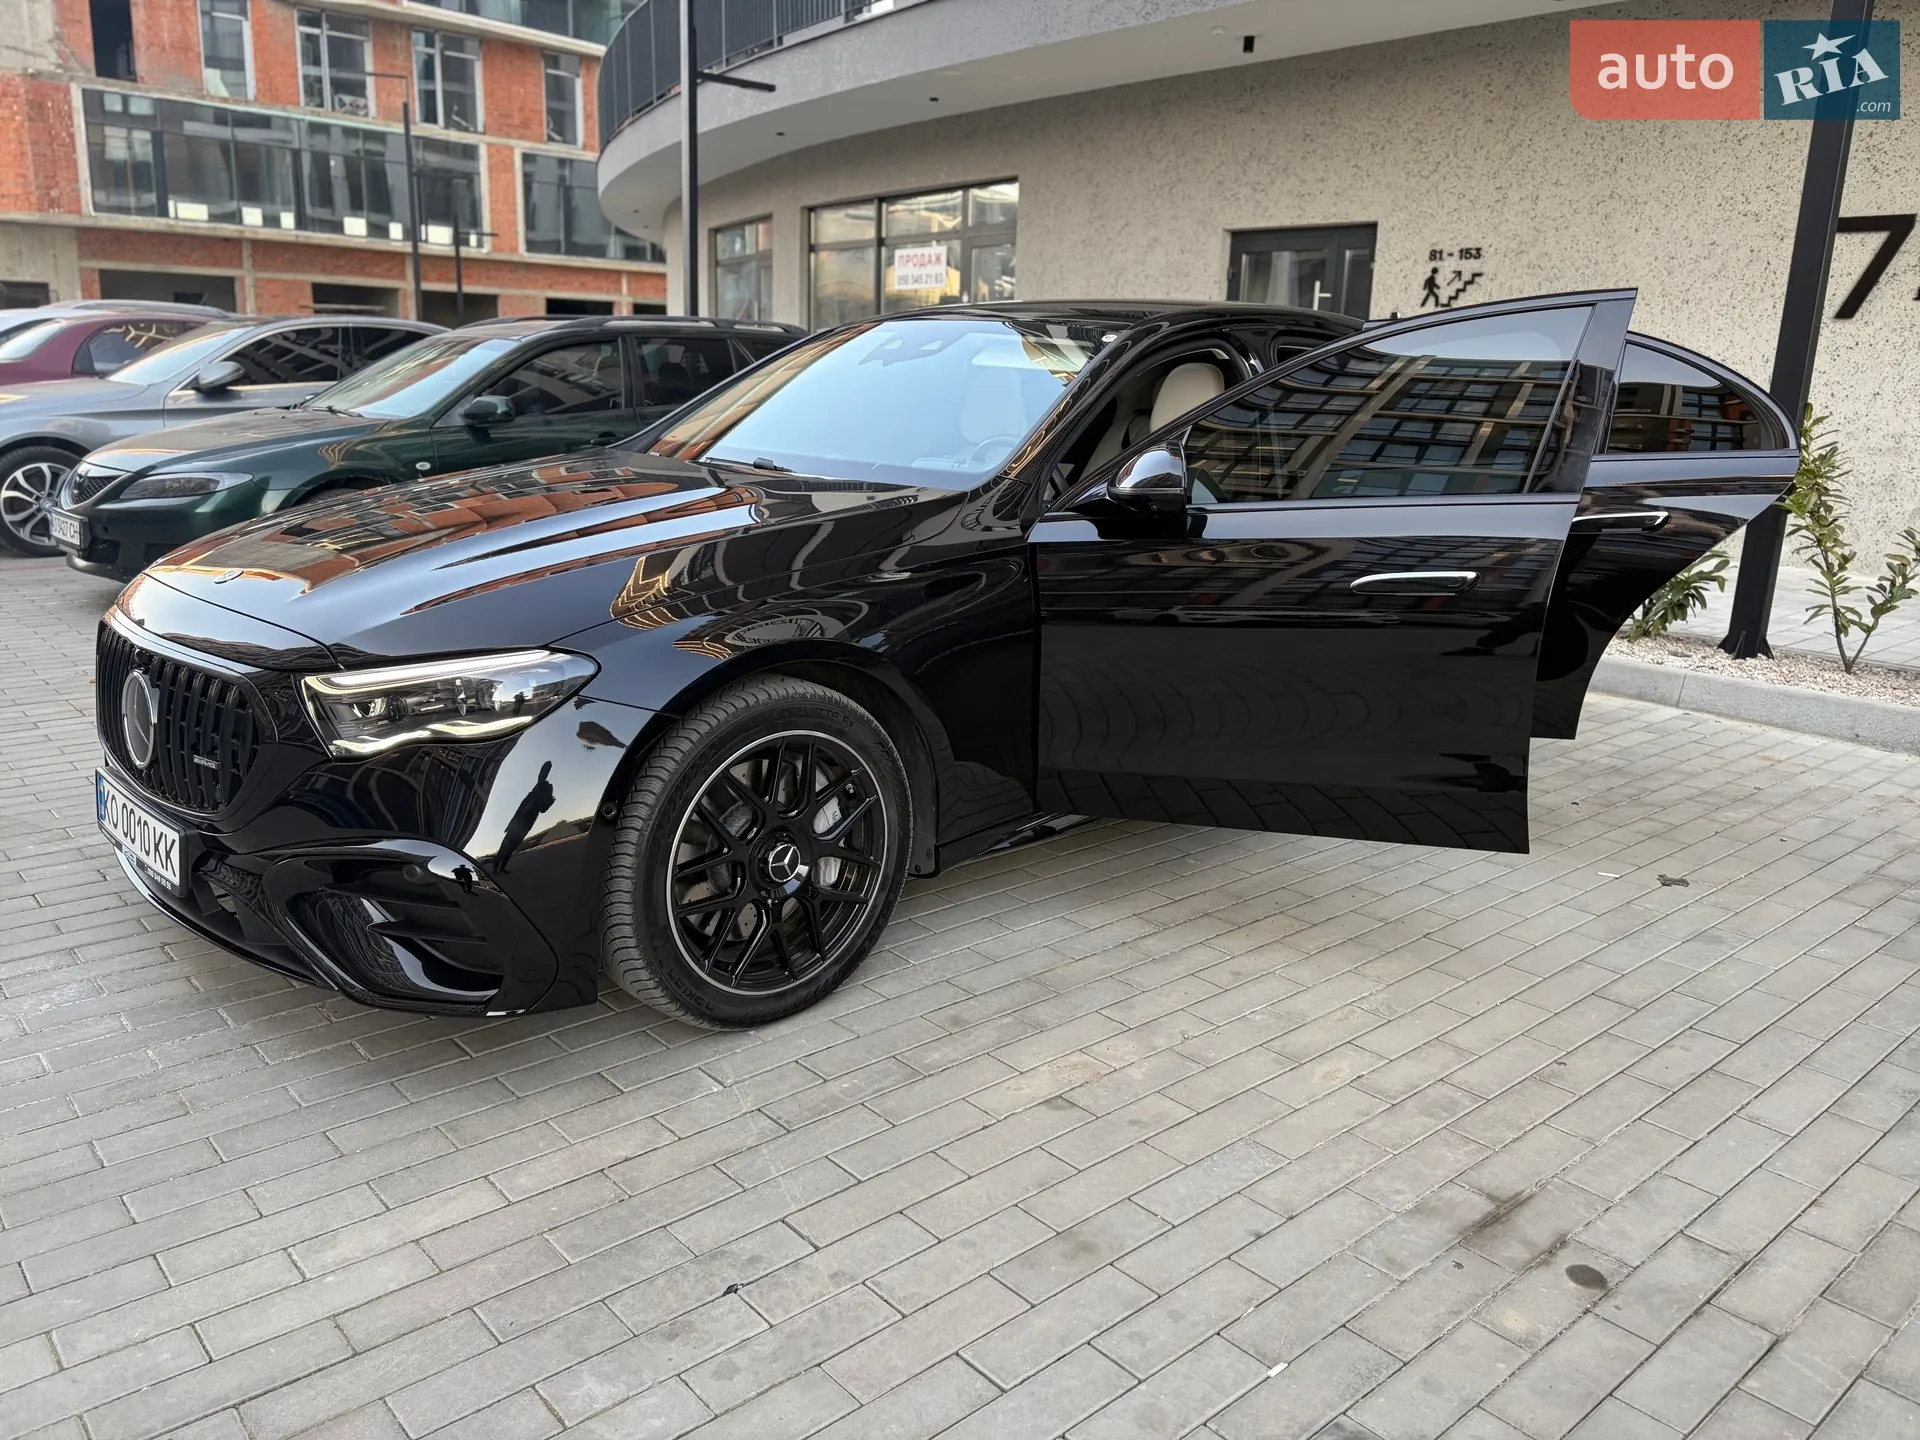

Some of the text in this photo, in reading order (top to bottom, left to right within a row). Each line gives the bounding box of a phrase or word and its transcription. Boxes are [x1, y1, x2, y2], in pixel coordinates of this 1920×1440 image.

[898, 252, 943, 268] ПРОДАЖ
[1428, 248, 1443, 261] 81
[1458, 247, 1482, 260] 153
[1833, 213, 1918, 319] 7
[103, 785, 118, 830] KO
[121, 802, 150, 857] 0010
[153, 825, 177, 878] KK
